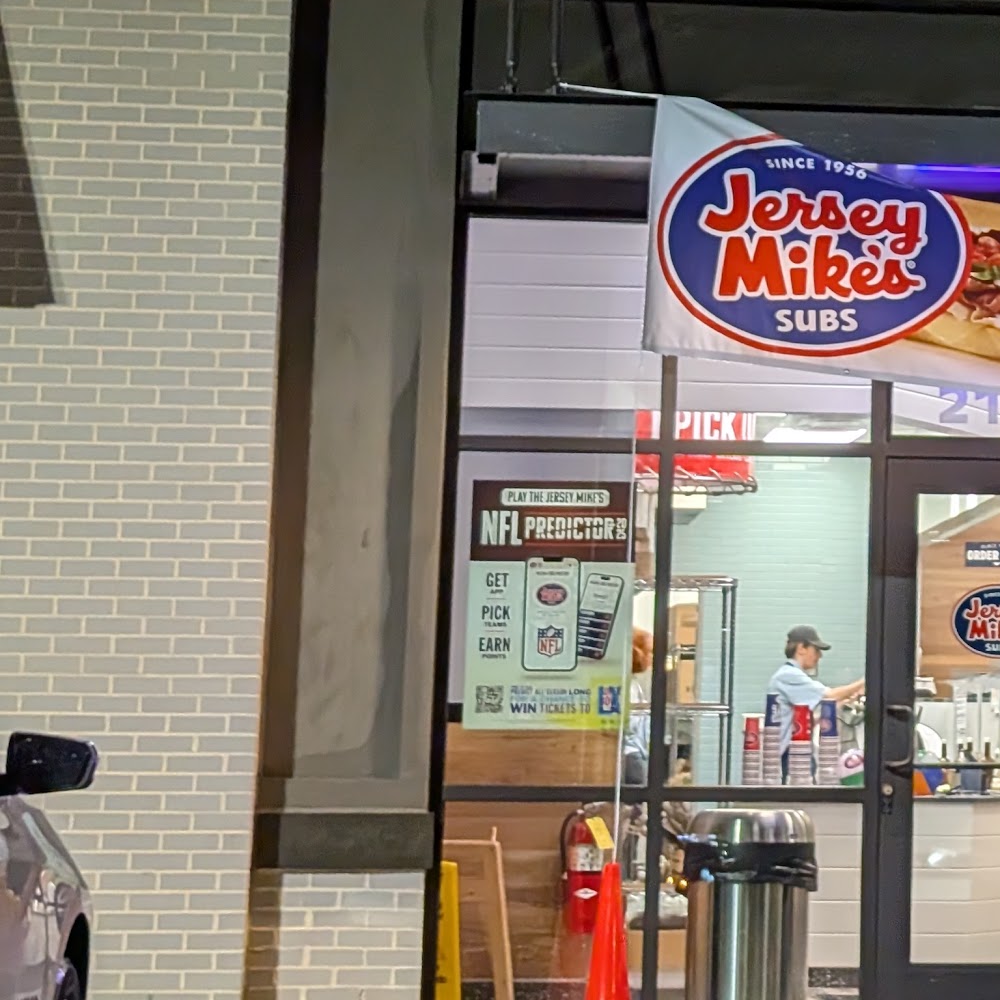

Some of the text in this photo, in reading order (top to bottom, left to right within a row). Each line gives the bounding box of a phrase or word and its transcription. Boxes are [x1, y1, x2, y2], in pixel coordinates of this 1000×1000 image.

[766, 157, 867, 181] SINCE 1956
[702, 171, 924, 256] Jersey
[716, 233, 922, 299] Mike's
[775, 308, 858, 333] SUBS
[674, 411, 738, 441] PICK
[508, 491, 604, 504] PLAY THE JERSEY MIKE'S
[480, 510, 614, 546] NFL PREDICTOR
[967, 550, 1000, 561] ORDER
[486, 572, 510, 588] GET
[481, 605, 511, 620] PICK
[478, 637, 511, 652] EARN
[540, 638, 561, 652] NFL
[510, 703, 591, 714] WIN TICKETS TO
